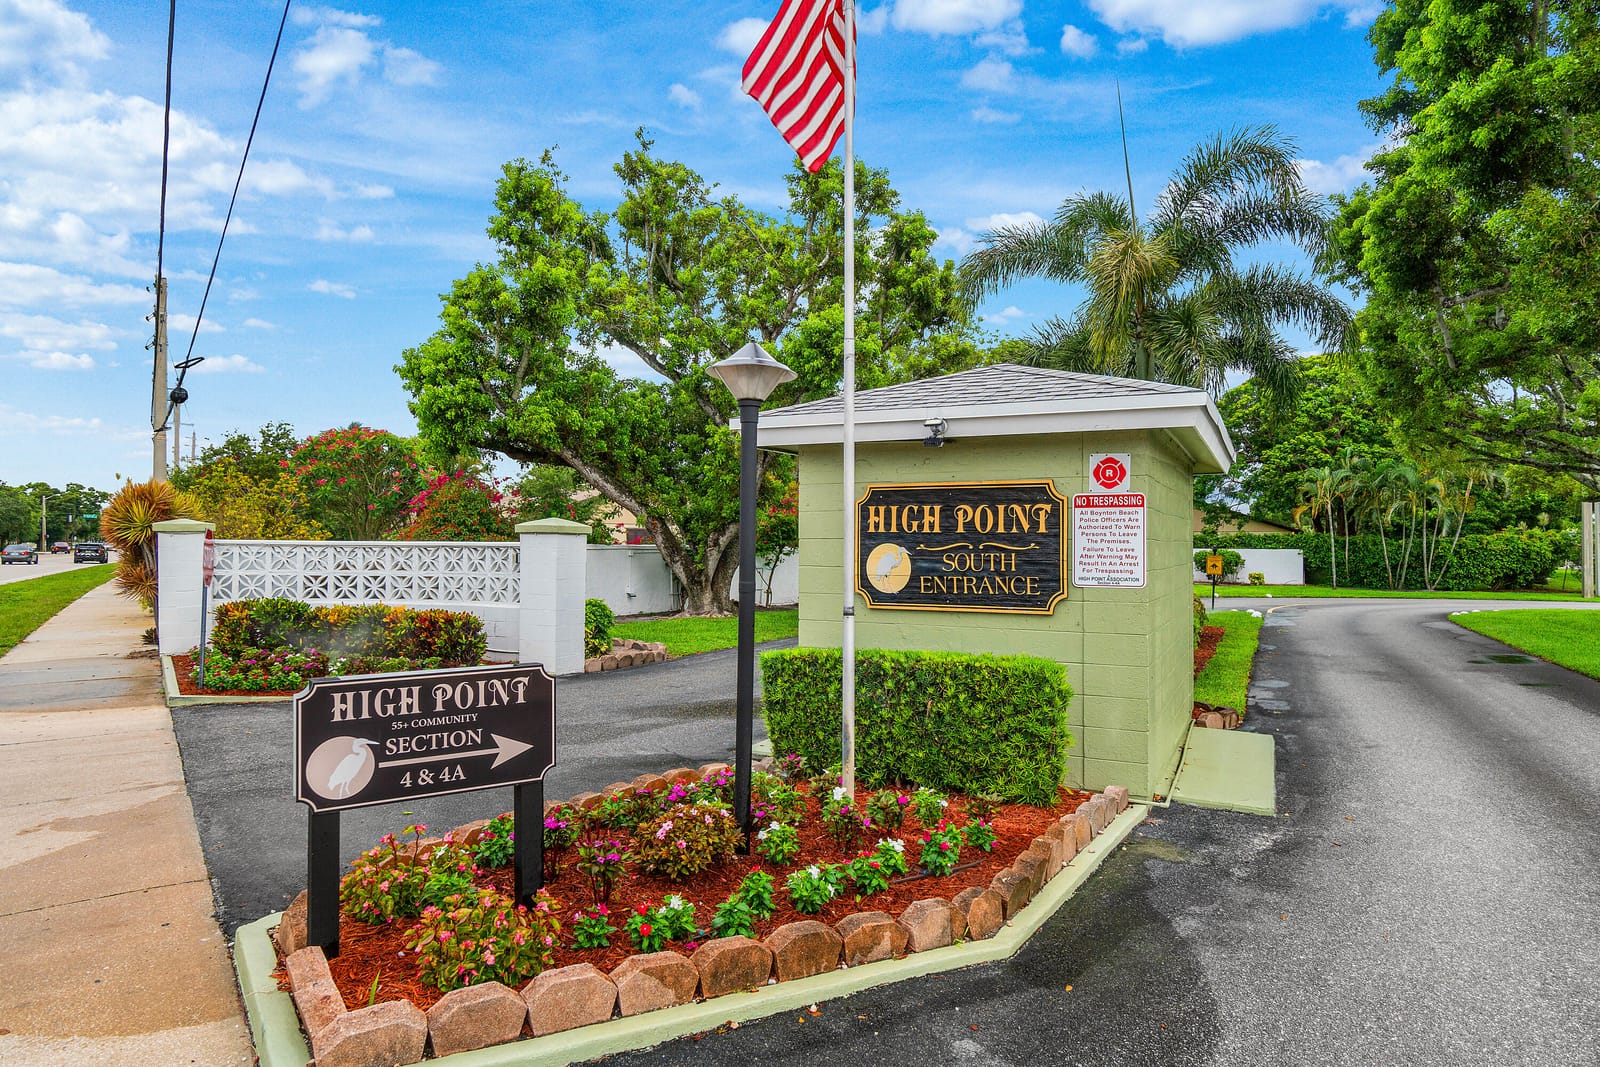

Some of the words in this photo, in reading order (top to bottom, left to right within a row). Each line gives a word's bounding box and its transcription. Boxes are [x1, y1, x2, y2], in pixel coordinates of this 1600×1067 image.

[1105, 469, 1114, 477] R
[1076, 497, 1087, 506] NO
[1089, 496, 1142, 506] TRESPASSING
[867, 505, 942, 533] HIGH
[954, 504, 1052, 533] POINT
[942, 552, 1016, 572] SOUTH
[919, 576, 1041, 595] ENTRANCE
[330, 686, 422, 722] HIGH
[432, 676, 530, 712] POINT
[391, 721, 409, 730] 55+
[411, 713, 478, 728] COMMUNITY
[385, 728, 483, 755] SECTION
[400, 772, 412, 788] 4
[418, 769, 434, 785] &
[440, 764, 467, 783] 4A
